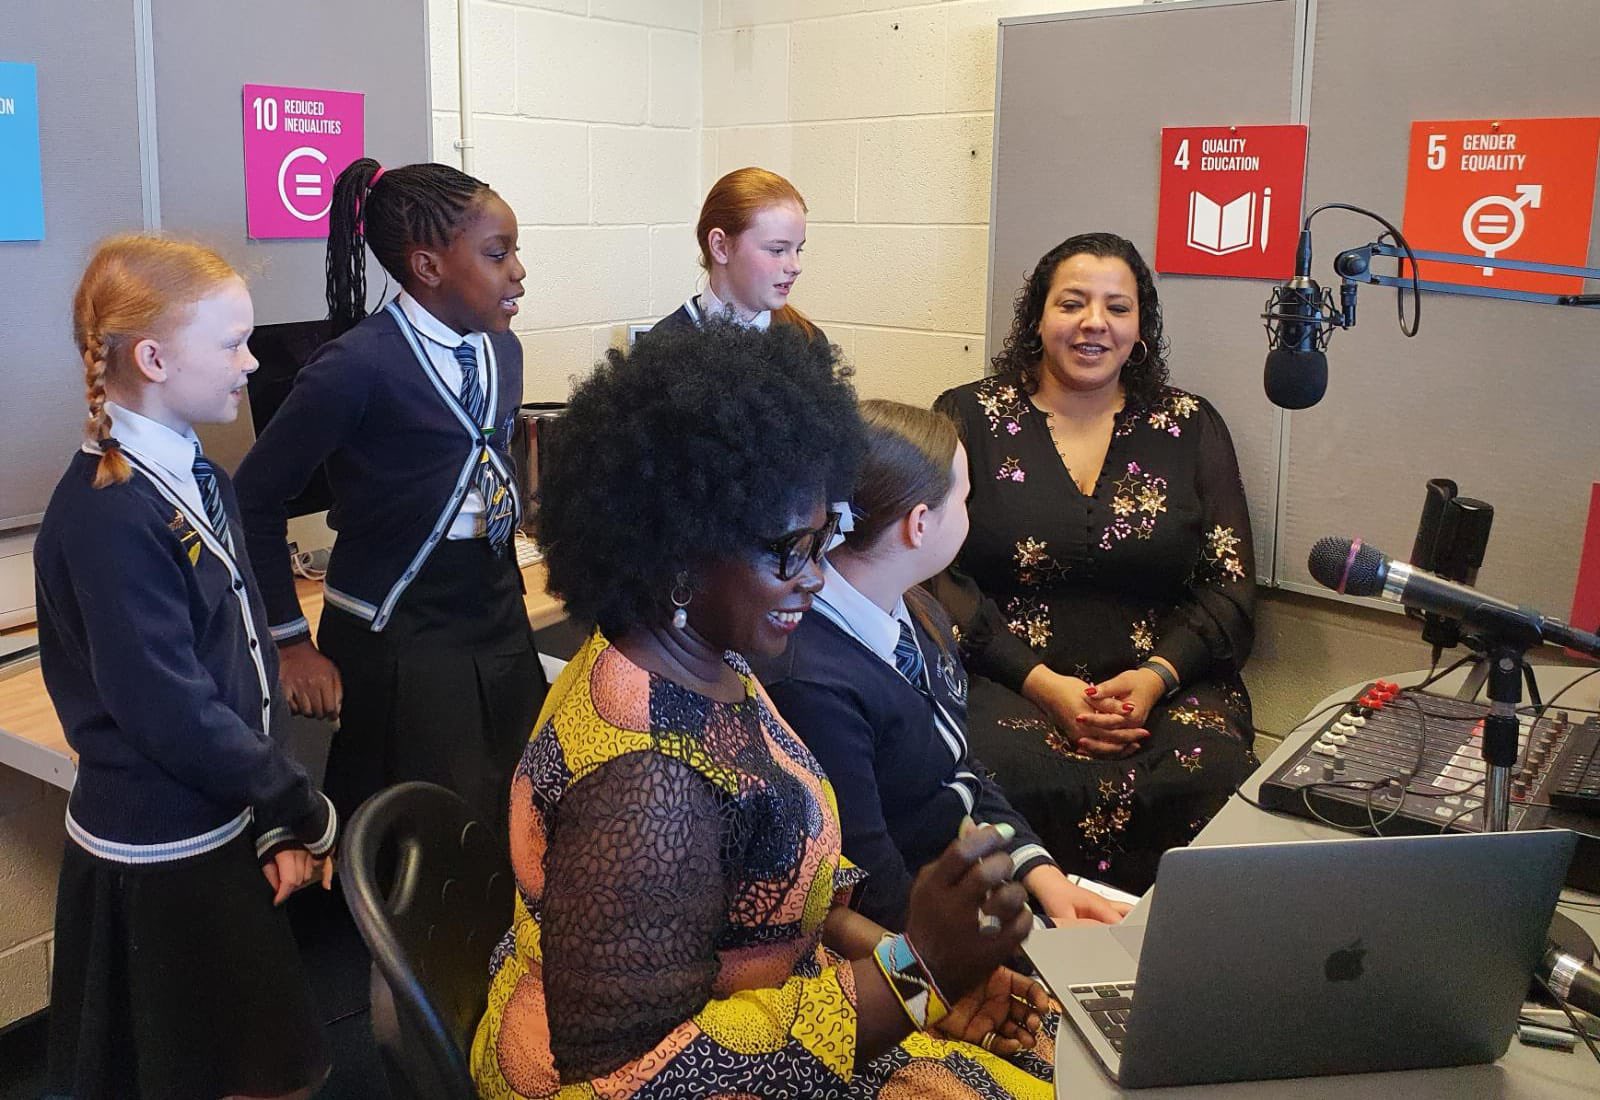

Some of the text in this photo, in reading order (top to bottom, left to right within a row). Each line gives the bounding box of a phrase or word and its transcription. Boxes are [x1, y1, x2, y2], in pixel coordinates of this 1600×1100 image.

[253, 97, 278, 131] 10
[284, 99, 325, 116] REDUCED
[284, 117, 342, 134] INEQUALITIES
[1202, 138, 1246, 154] QUALITY
[1463, 134, 1516, 151] GENDER
[1174, 139, 1190, 170] 4
[1427, 134, 1447, 170] 5
[1201, 156, 1260, 171] EDUCATION
[1461, 154, 1527, 172] EQUALITY
